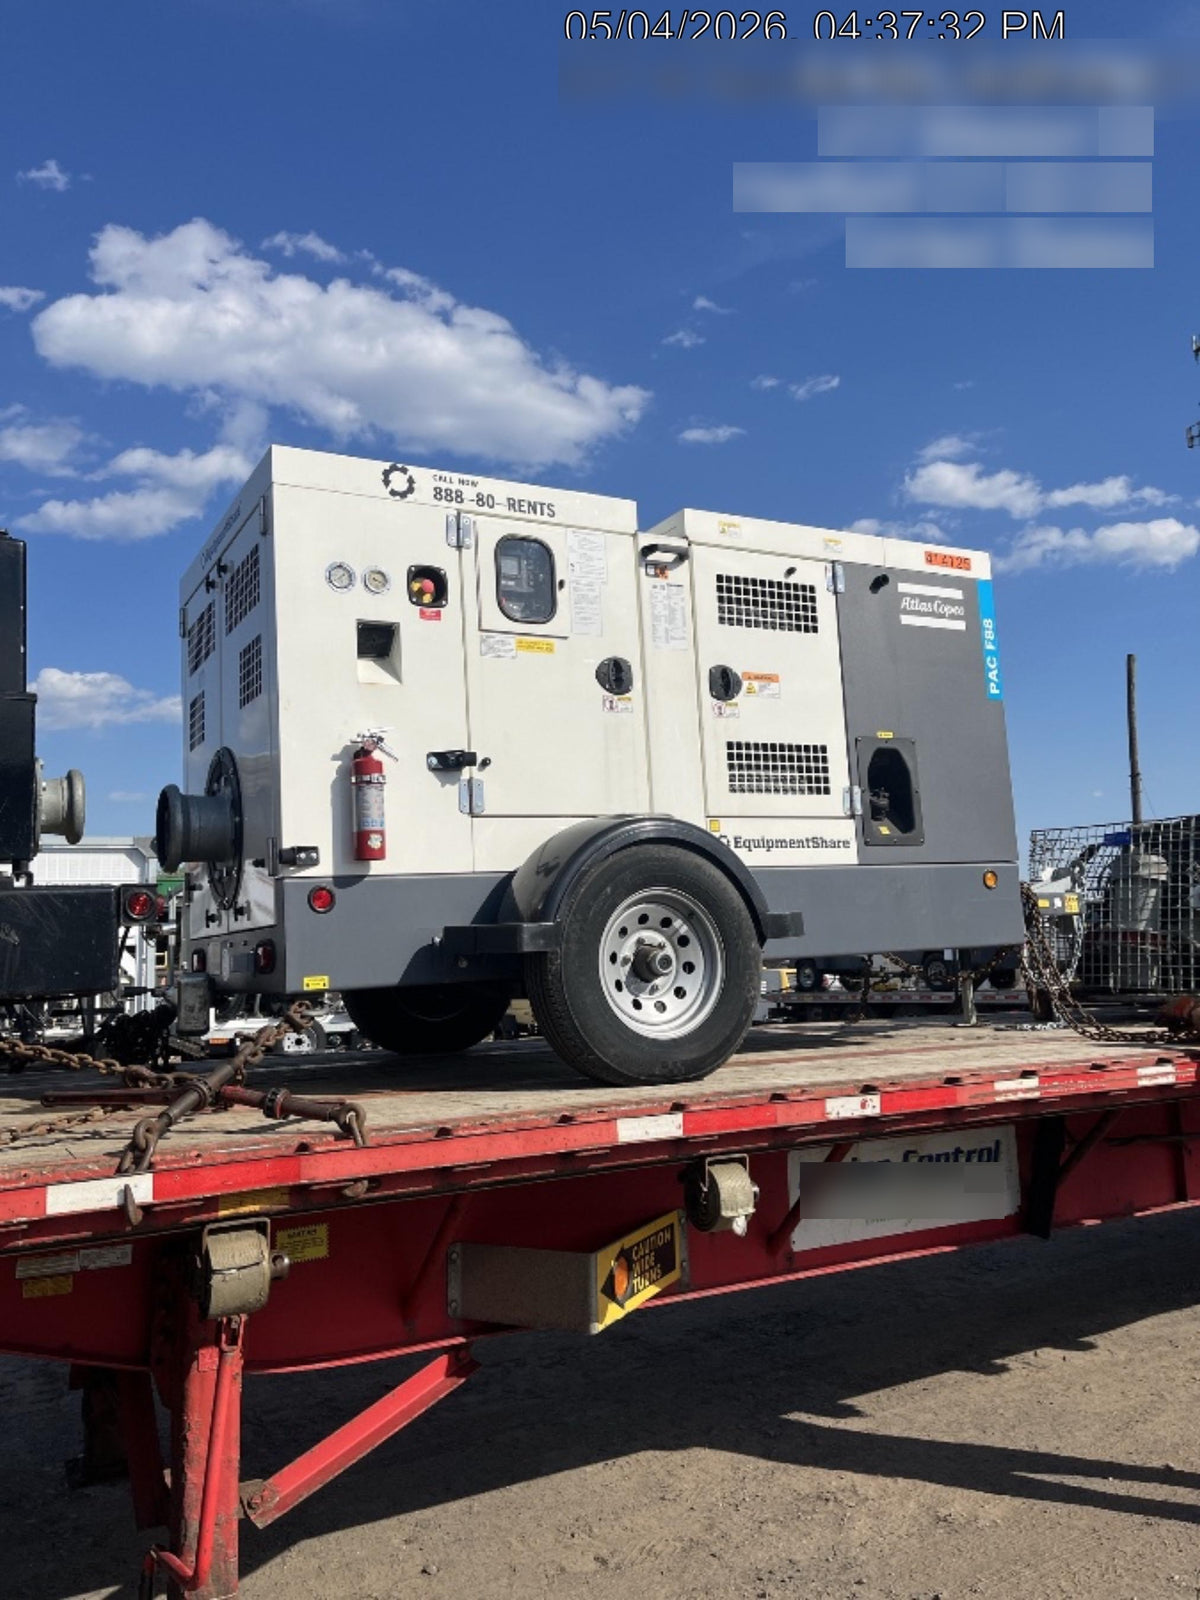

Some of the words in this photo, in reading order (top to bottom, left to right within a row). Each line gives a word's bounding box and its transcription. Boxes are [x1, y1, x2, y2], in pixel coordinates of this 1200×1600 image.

[432, 474, 455, 485] CALL
[900, 596, 932, 613] Atlas
[933, 600, 965, 618] Copco
[986, 656, 1000, 694] PAC
[733, 836, 850, 852] EquipmentShare
